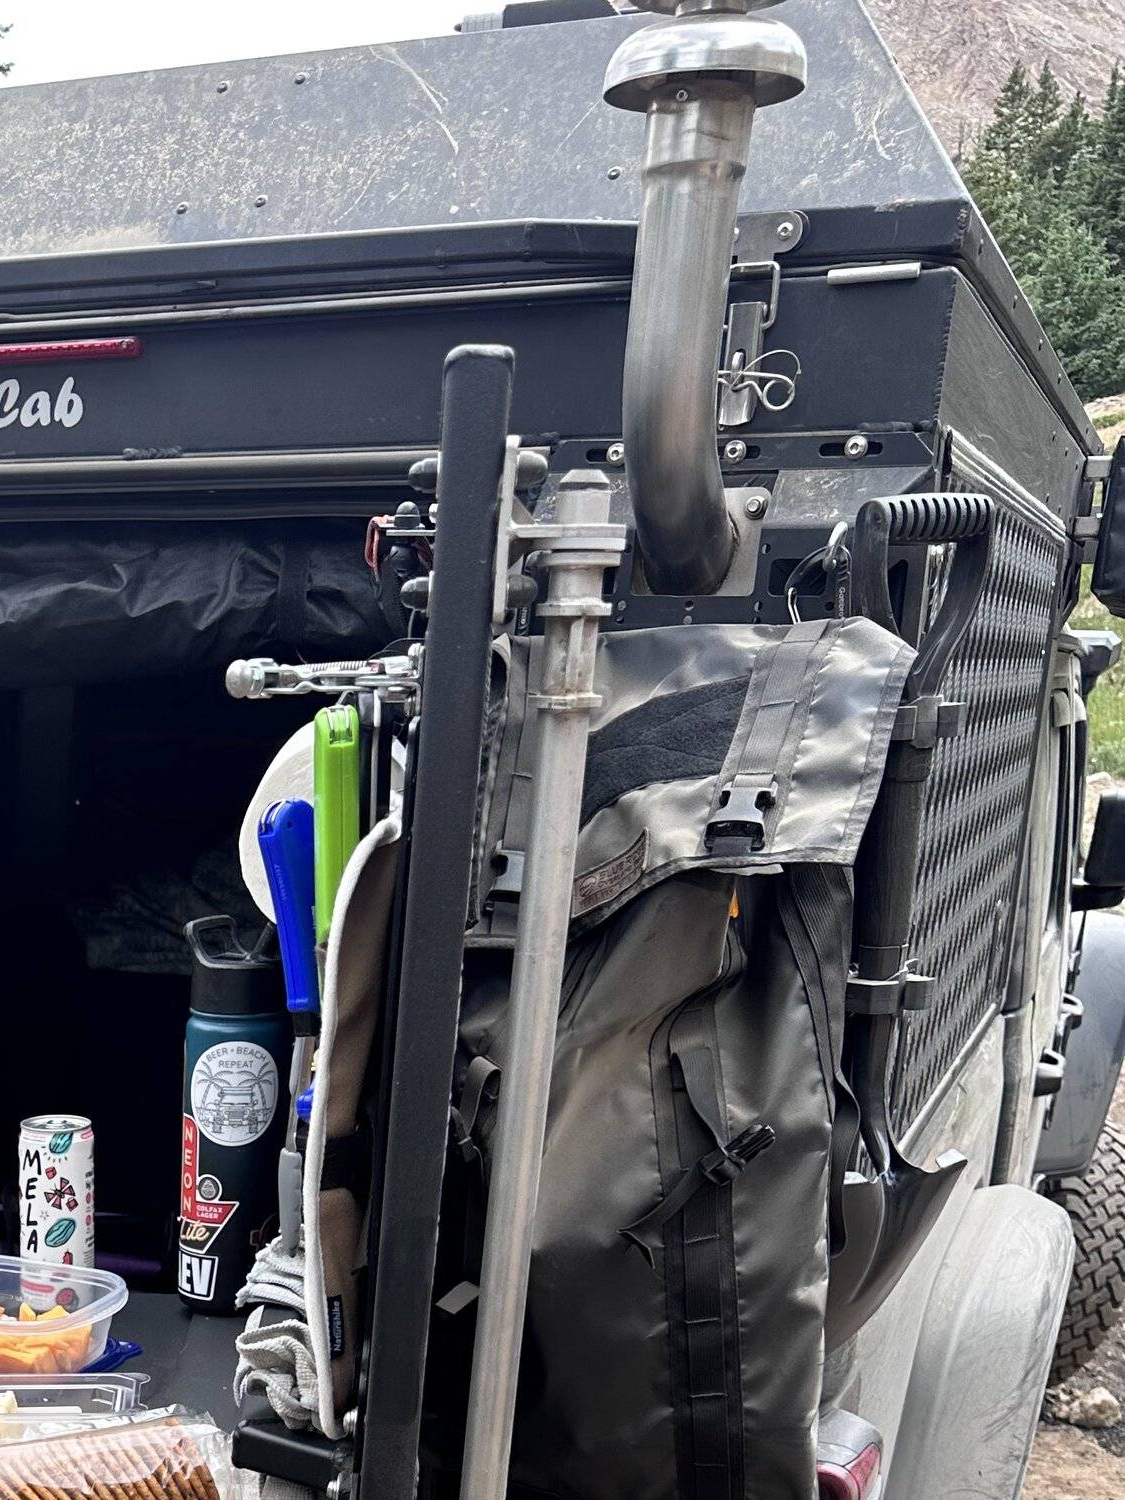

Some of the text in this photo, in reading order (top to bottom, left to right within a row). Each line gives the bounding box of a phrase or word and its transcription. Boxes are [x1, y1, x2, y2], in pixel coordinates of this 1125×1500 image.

[205, 1046, 267, 1063] BEER BEACH
[218, 1060, 254, 1069] REPEAT
[182, 1126, 194, 1214] NEON
[22, 1149, 42, 1254] MELA
